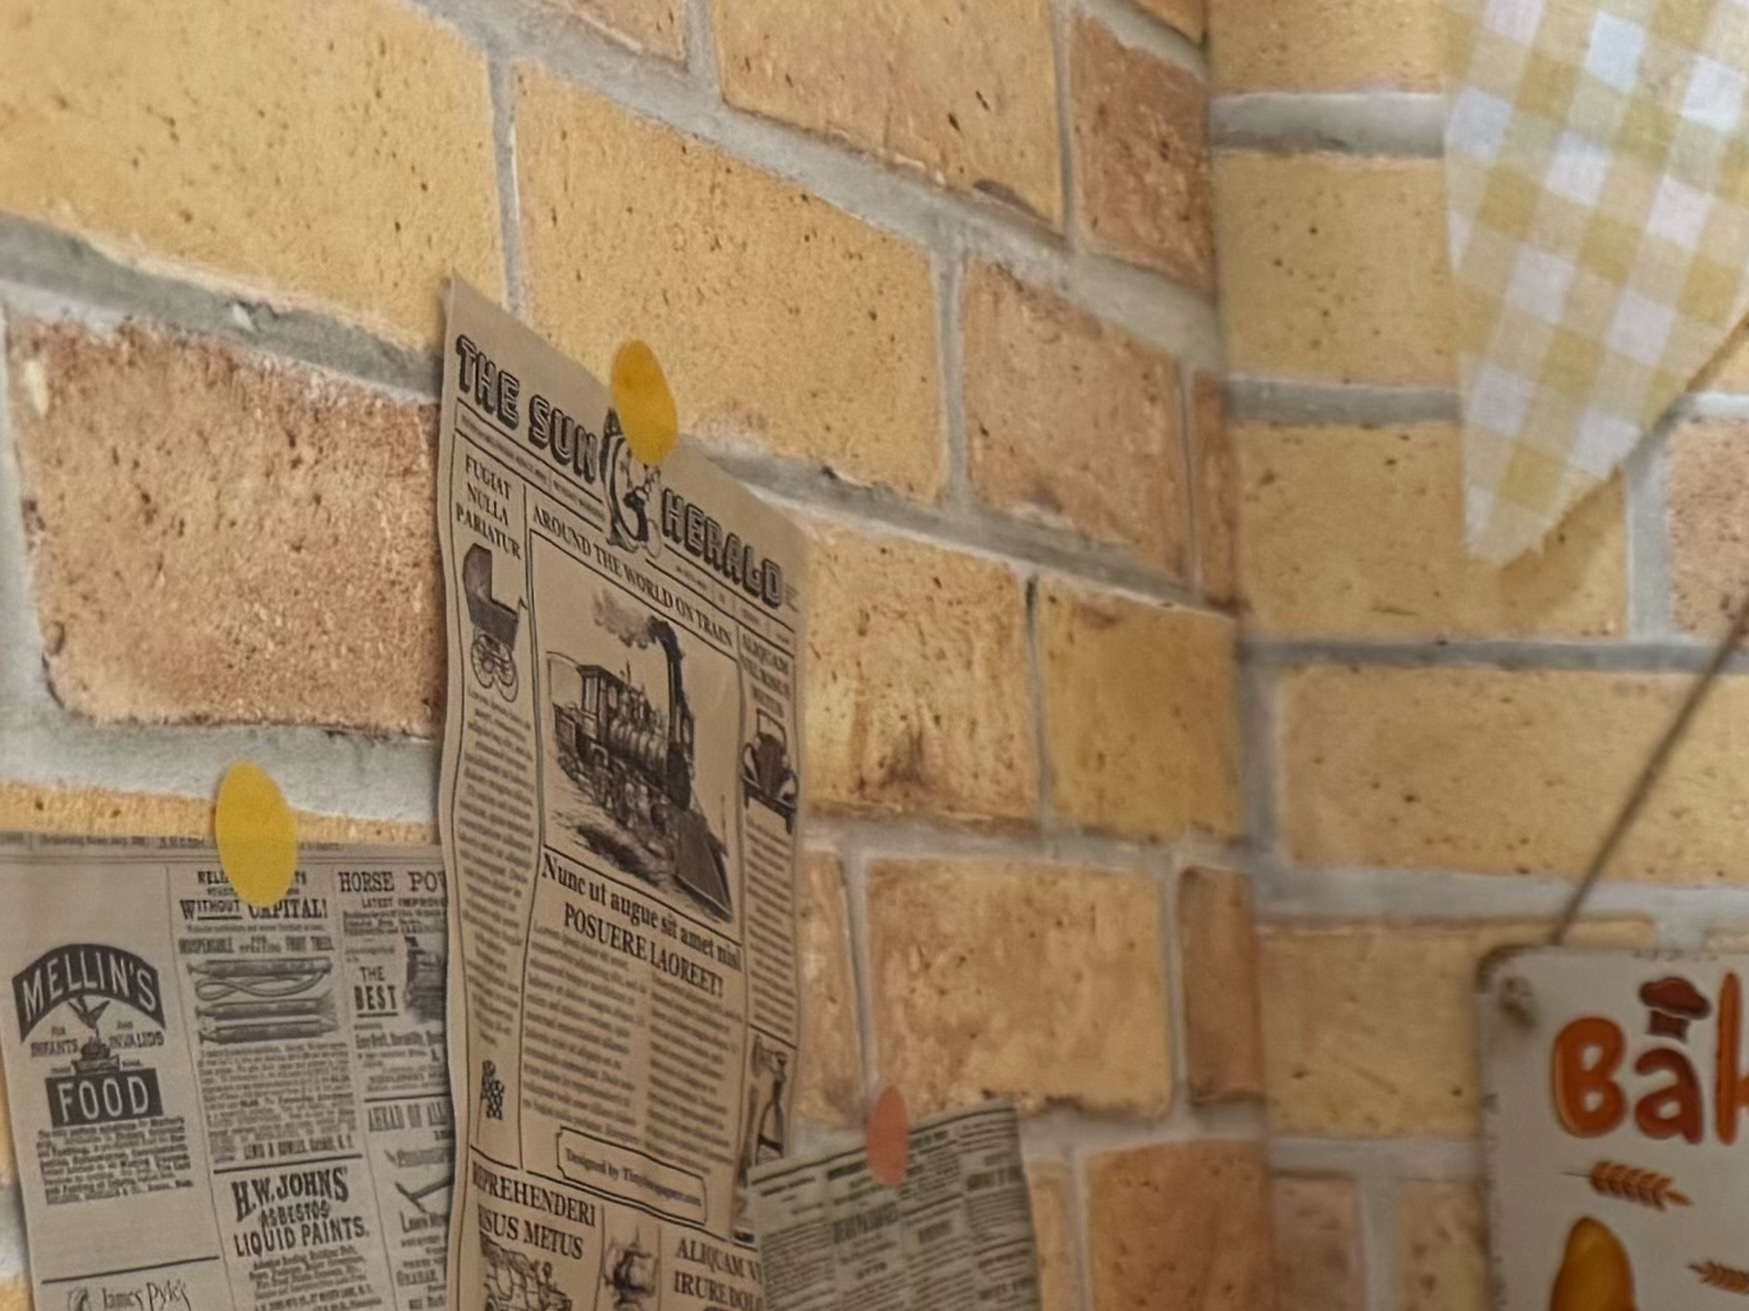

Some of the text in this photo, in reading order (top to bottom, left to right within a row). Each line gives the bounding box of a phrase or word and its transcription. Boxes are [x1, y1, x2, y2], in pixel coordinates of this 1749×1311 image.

[456, 334, 520, 431] THE
[528, 394, 598, 484] SUN
[661, 487, 783, 609] HERALD
[465, 454, 513, 500] FUGIAT
[466, 482, 509, 527] NULLA
[456, 502, 521, 560] PARIATUR
[533, 504, 592, 557] AROUND
[593, 543, 622, 579] THE
[622, 562, 673, 609] WORLD
[692, 608, 733, 649] TRAIN
[338, 870, 395, 893] HORSE
[541, 852, 586, 900] Nunc
[589, 883, 607, 907] ut
[610, 892, 659, 929] augue
[661, 913, 678, 941] sit
[564, 901, 725, 999] POSUERE LAOREET!
[23, 950, 157, 1022] MELLIN'S
[354, 985, 398, 1011] BEST
[360, 966, 385, 983] THE
[57, 1076, 150, 1124] FOOD
[234, 1226, 298, 1258] LIQUID
[523, 1223, 584, 1261] METUS
